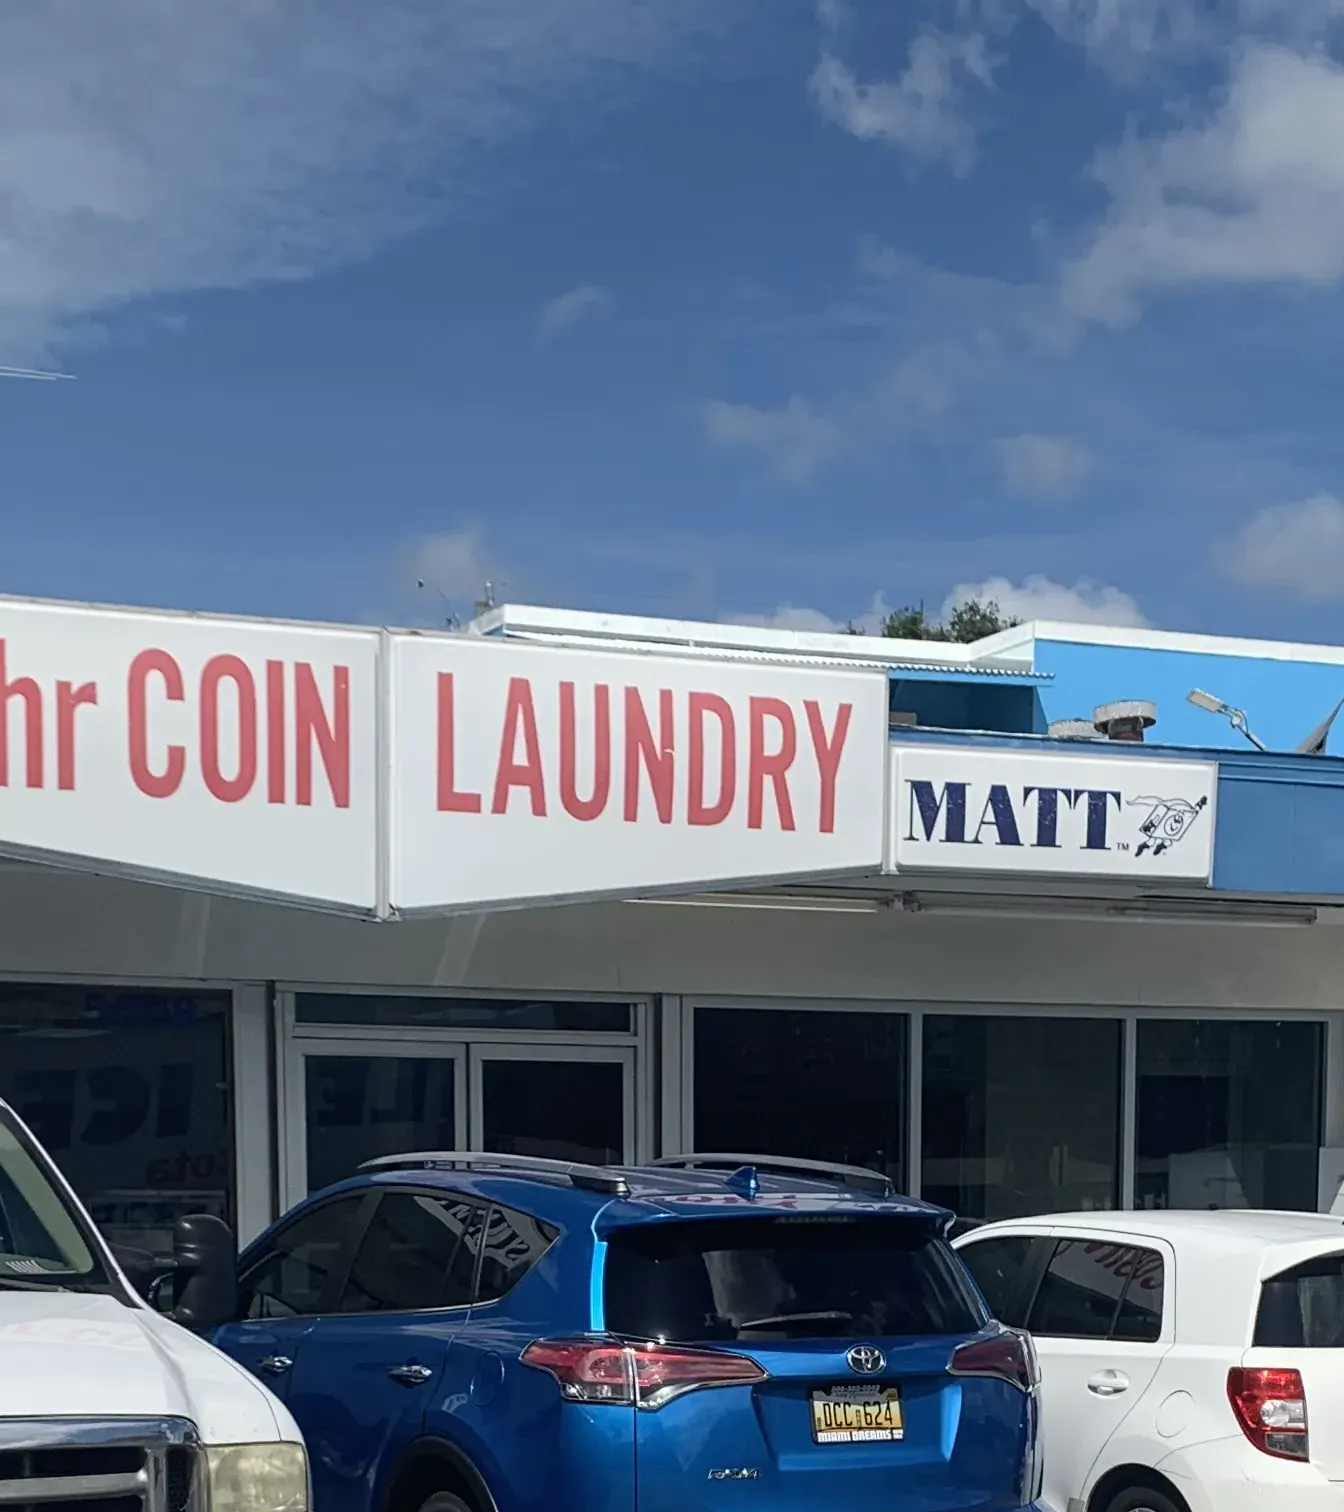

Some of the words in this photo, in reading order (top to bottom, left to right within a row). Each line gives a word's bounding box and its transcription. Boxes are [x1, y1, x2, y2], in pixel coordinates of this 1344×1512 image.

[127, 647, 351, 810] COIN
[436, 671, 853, 834] LAUNDRY
[903, 778, 1122, 851] MATT
[817, 1431, 851, 1443] MIAMI
[852, 1429, 892, 1441] DREAMS
[863, 1400, 893, 1427] 624
